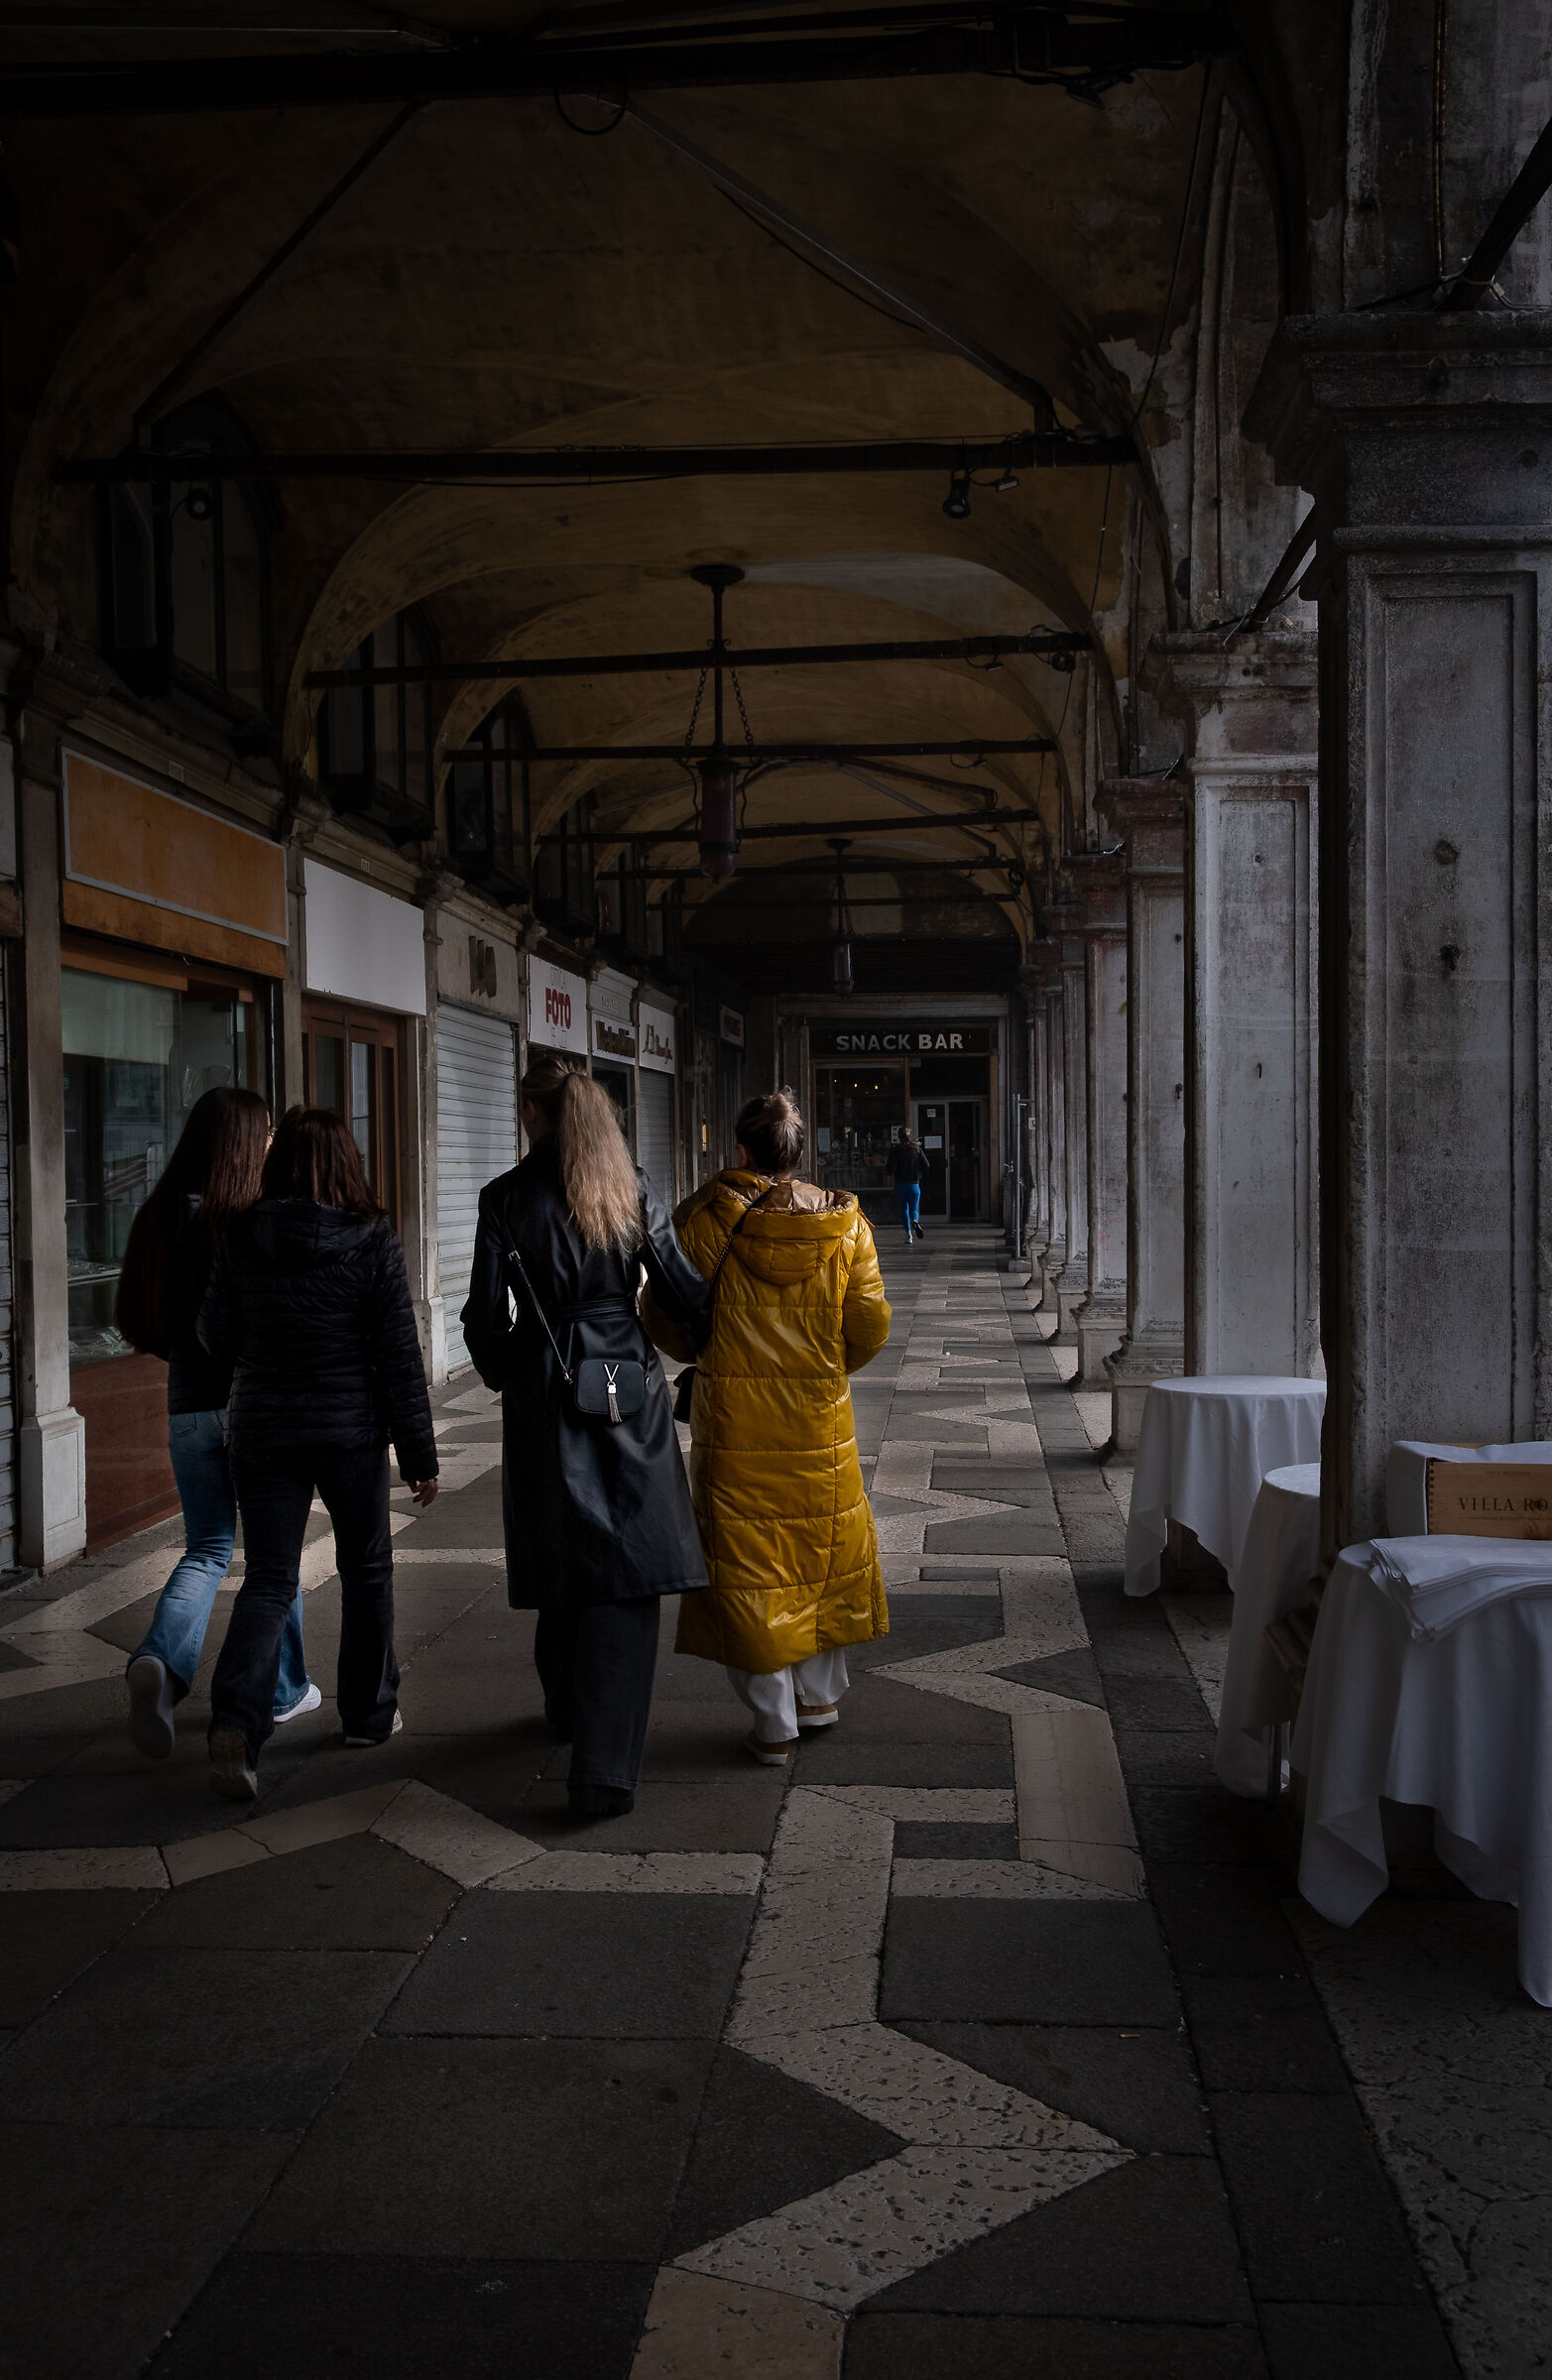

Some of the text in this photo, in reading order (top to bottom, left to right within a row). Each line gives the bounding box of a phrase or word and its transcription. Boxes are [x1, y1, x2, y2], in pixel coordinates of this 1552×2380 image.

[544, 987, 571, 1029] FOTO
[835, 1032, 965, 1051] SNACK BAR
[1459, 1496, 1514, 1511] VILLA
